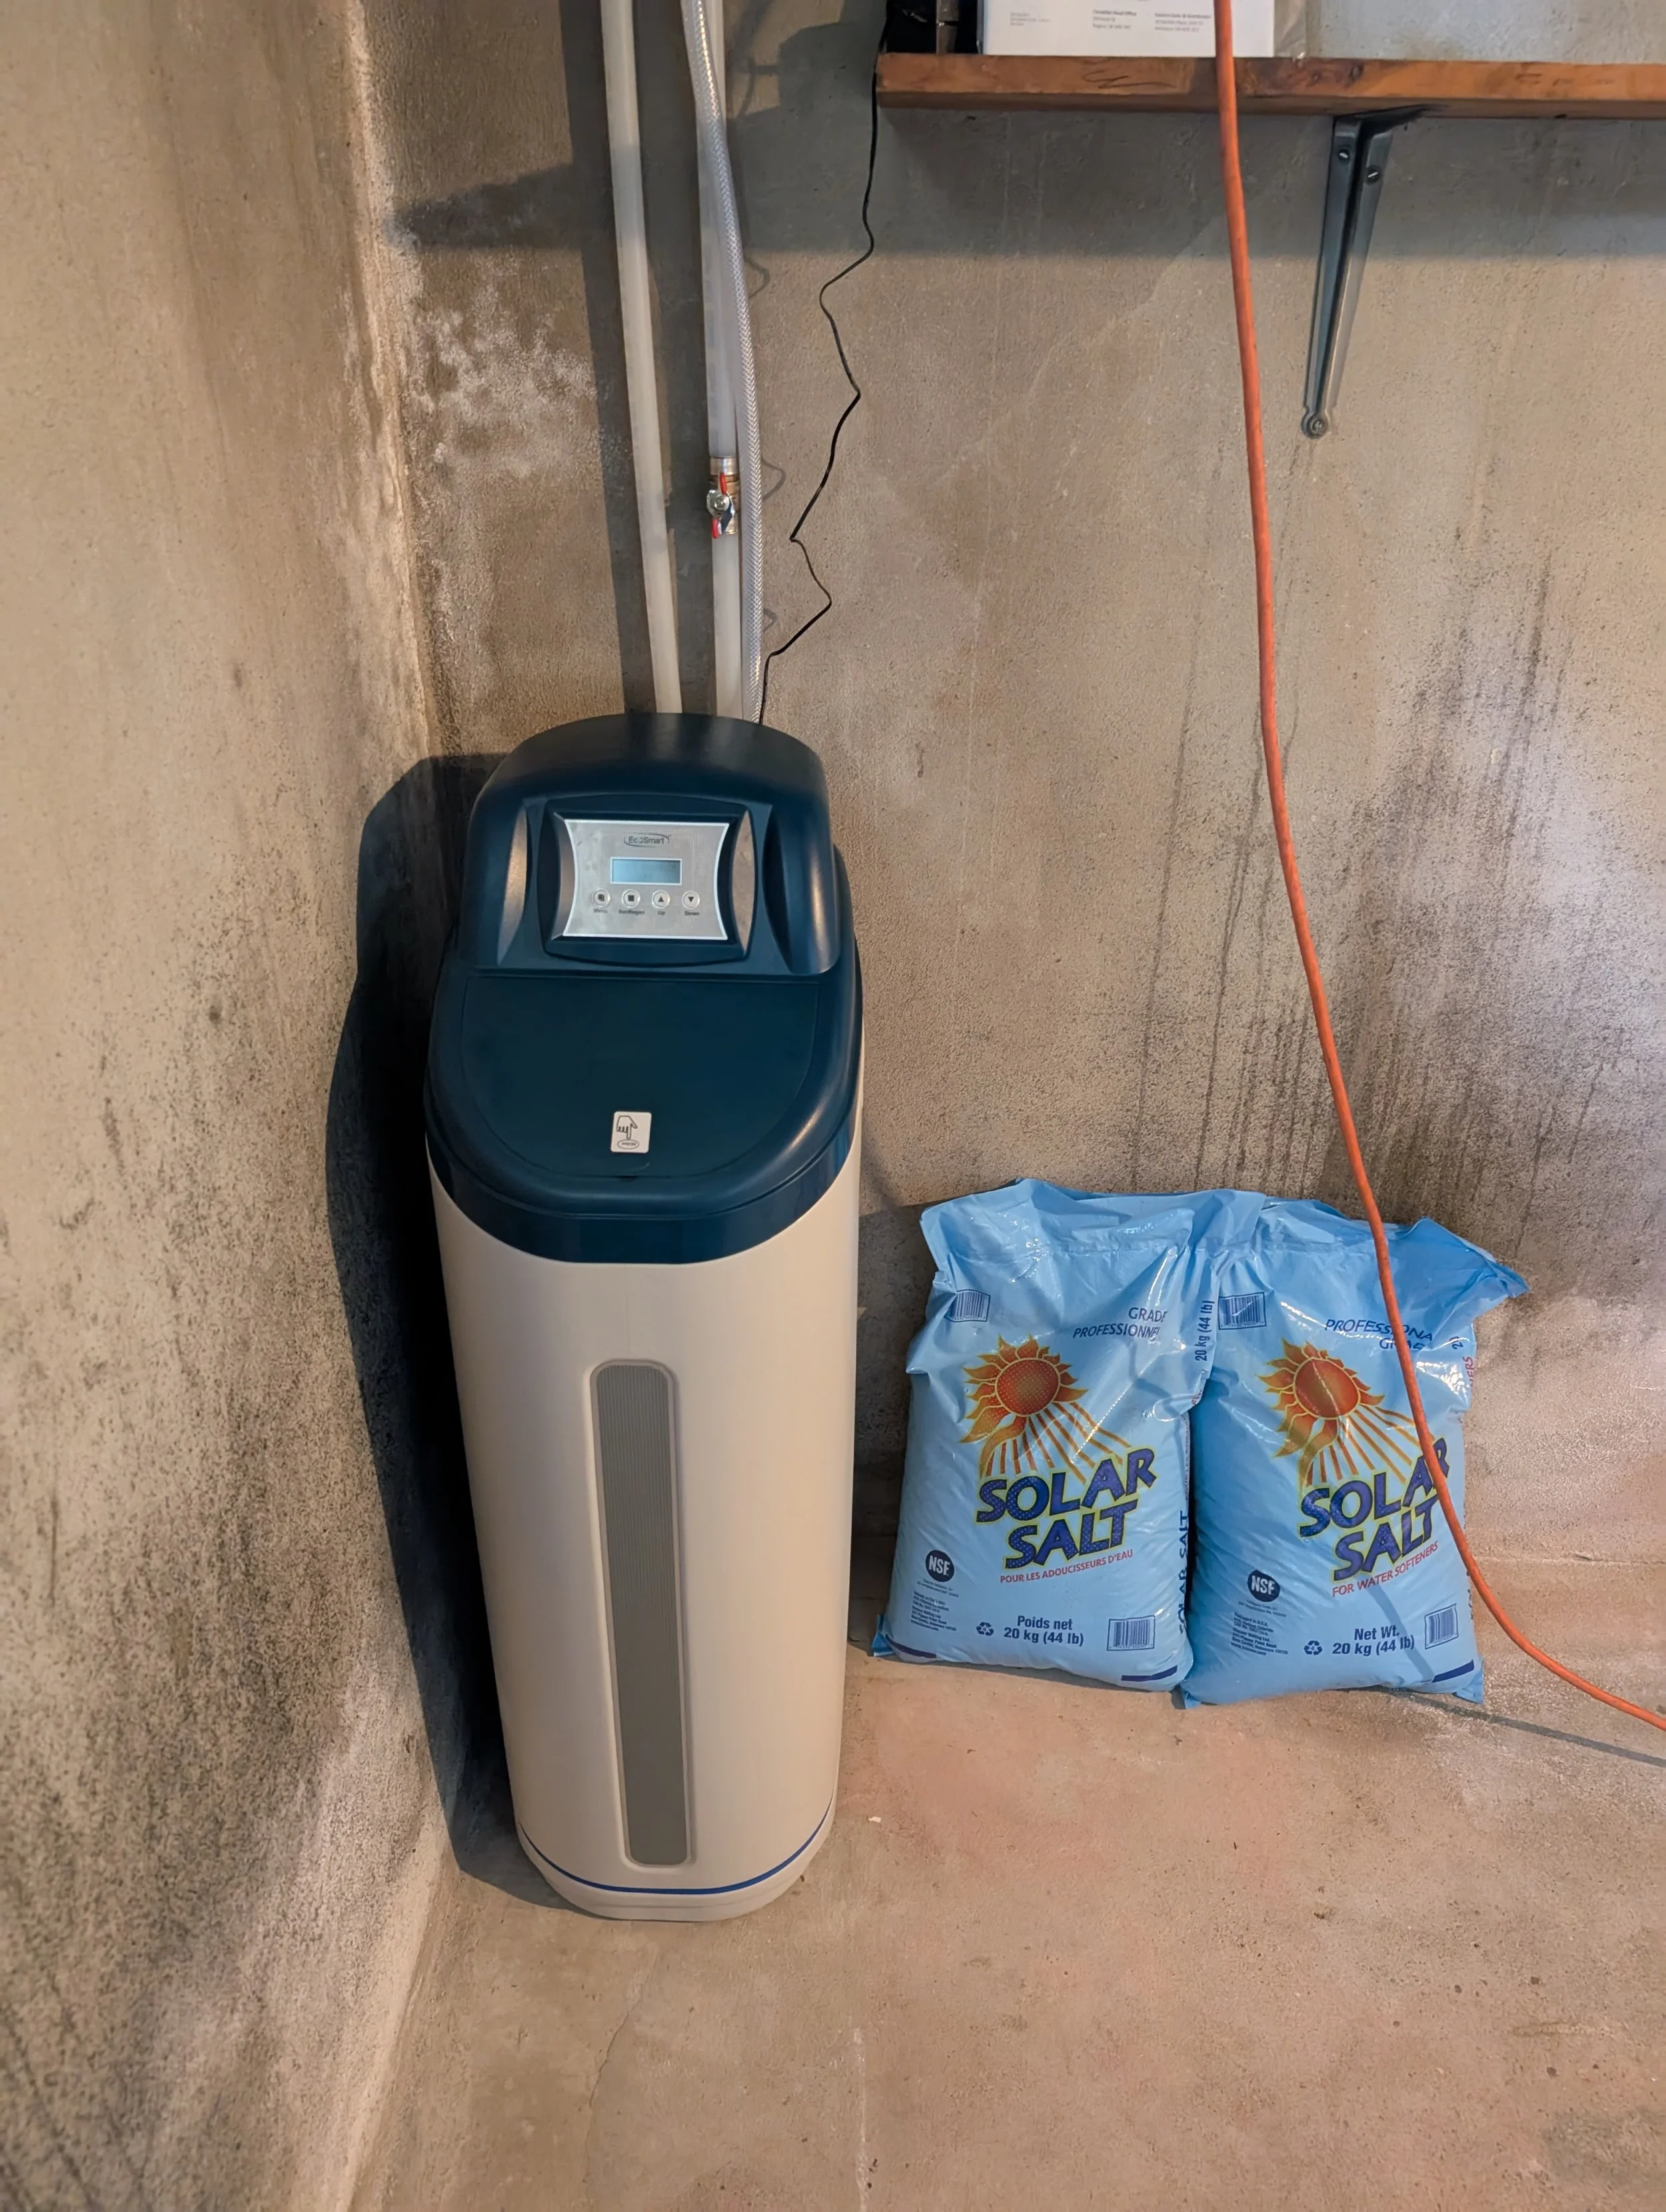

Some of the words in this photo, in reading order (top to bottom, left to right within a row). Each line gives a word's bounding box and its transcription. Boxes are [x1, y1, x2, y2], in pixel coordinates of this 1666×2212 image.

[1198, 1317, 1212, 1333] (44
[1195, 1335, 1210, 1347] kg
[1195, 1350, 1207, 1361] 20
[976, 1448, 1157, 1522] SOLAR
[1005, 1498, 1138, 1569] SALT
[1333, 1494, 1439, 1581] SALT
[929, 1555, 950, 1576] NSF
[1000, 1574, 1024, 1584] POUR
[1026, 1572, 1040, 1581] LES
[1042, 1559, 1106, 1578] ADOUCISSEURS
[1108, 1549, 1133, 1564] D'EAU
[1332, 1584, 1354, 1597] FOR
[1357, 1571, 1393, 1589] WATER
[1395, 1541, 1438, 1577] SOFTENERS
[1251, 1575, 1275, 1595] NSF
[1017, 1615, 1050, 1629] Poids
[1054, 1618, 1073, 1630] net
[1354, 1628, 1377, 1640] Net
[1381, 1624, 1399, 1639] Wt.
[1004, 1627, 1020, 1639] 20
[1023, 1630, 1039, 1644] kg
[1043, 1632, 1063, 1644] (44
[1067, 1632, 1084, 1647] lb)
[1332, 1642, 1351, 1654] 20
[1354, 1642, 1371, 1657] kg
[1376, 1639, 1396, 1656] (44
[1399, 1634, 1415, 1650] lb)
